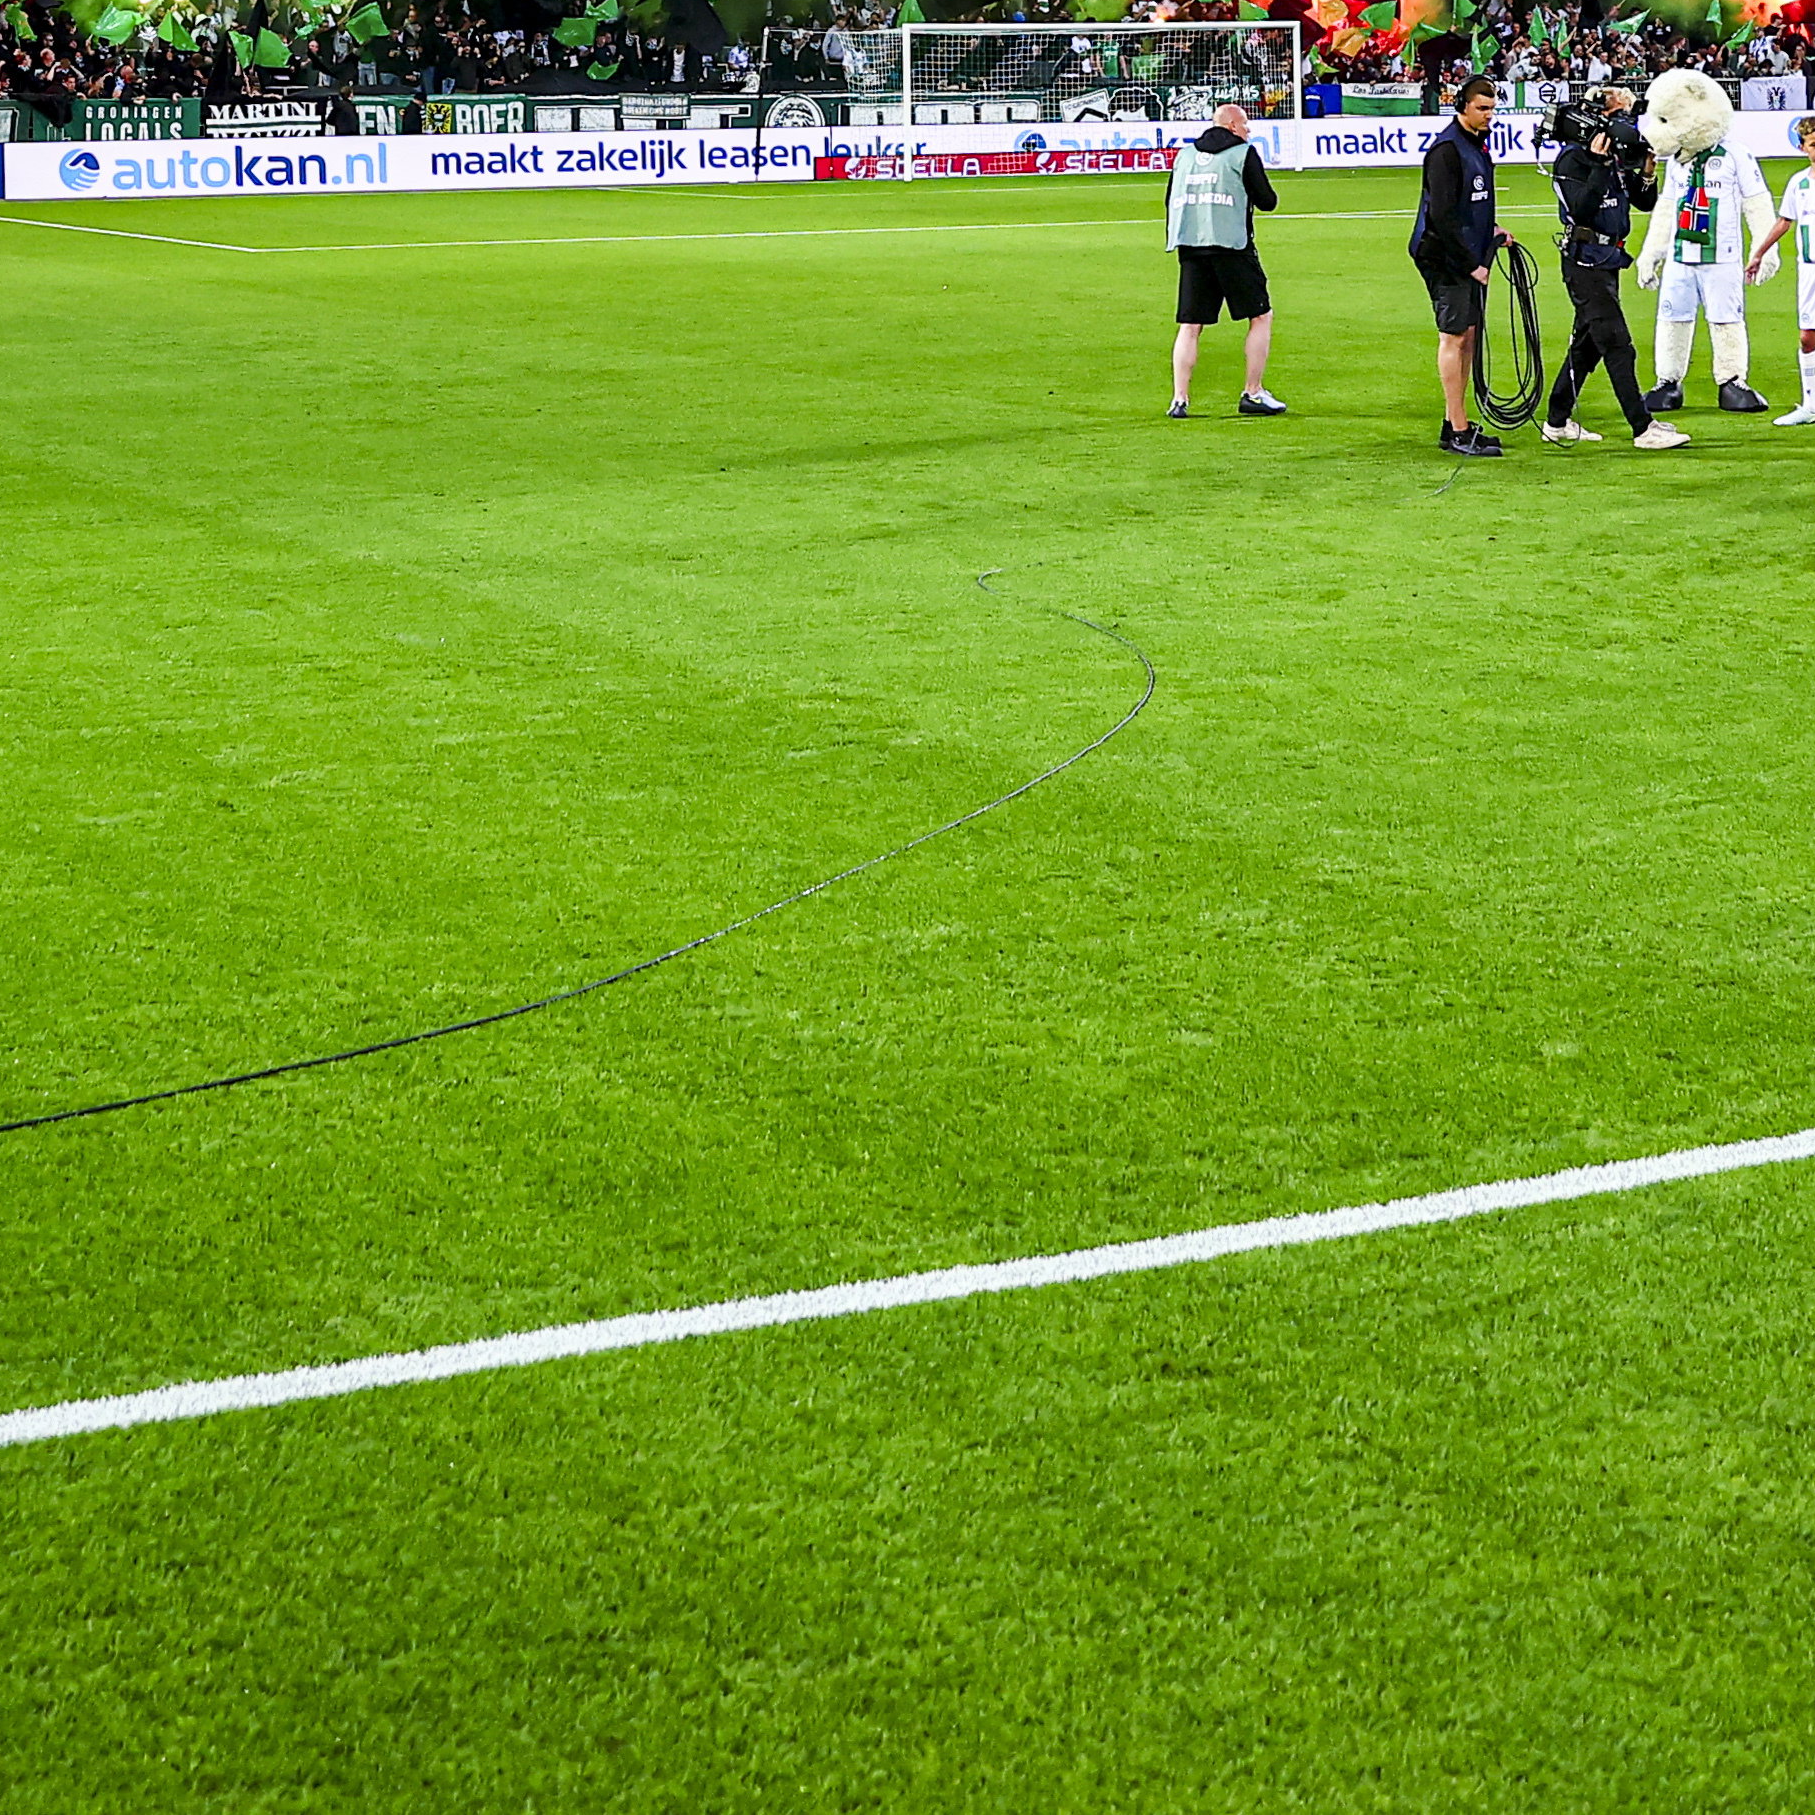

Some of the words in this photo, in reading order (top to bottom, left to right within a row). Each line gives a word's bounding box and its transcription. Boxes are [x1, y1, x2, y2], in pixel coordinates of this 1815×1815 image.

[85, 105, 182, 120] GRONINGEN
[207, 101, 319, 123] MARTINI
[85, 122, 182, 141] LOCALS
[113, 142, 387, 190] autokan.nl
[431, 143, 544, 175] maakt
[556, 139, 687, 178] zakelijk
[699, 136, 811, 168] leasen
[1316, 126, 1408, 156] maakt
[1198, 192, 1234, 206] MEDIA
